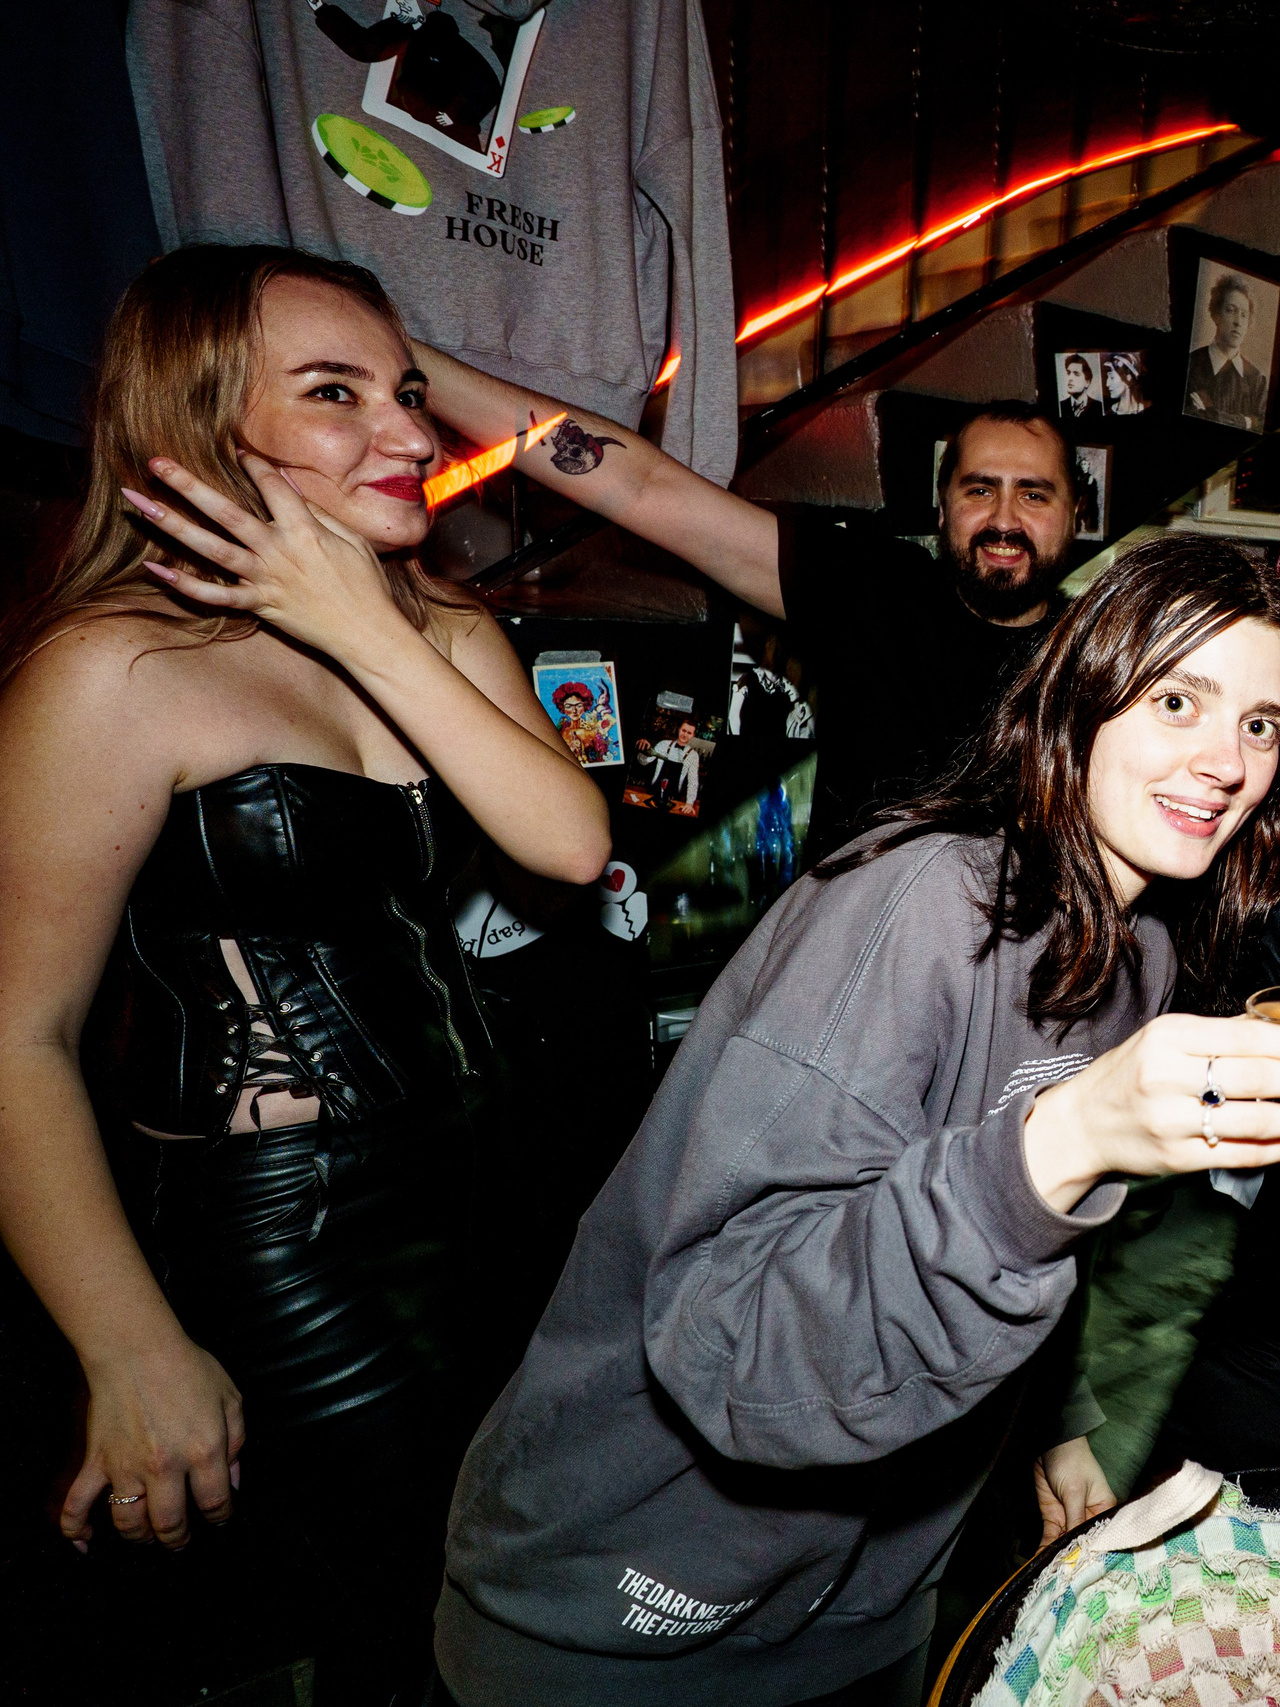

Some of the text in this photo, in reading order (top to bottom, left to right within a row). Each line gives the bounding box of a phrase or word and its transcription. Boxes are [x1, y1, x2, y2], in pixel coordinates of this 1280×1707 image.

[487, 151, 504, 174] K
[465, 191, 560, 242] FRESH
[445, 215, 544, 267] HOUSE
[486, 920, 526, 946] бар
